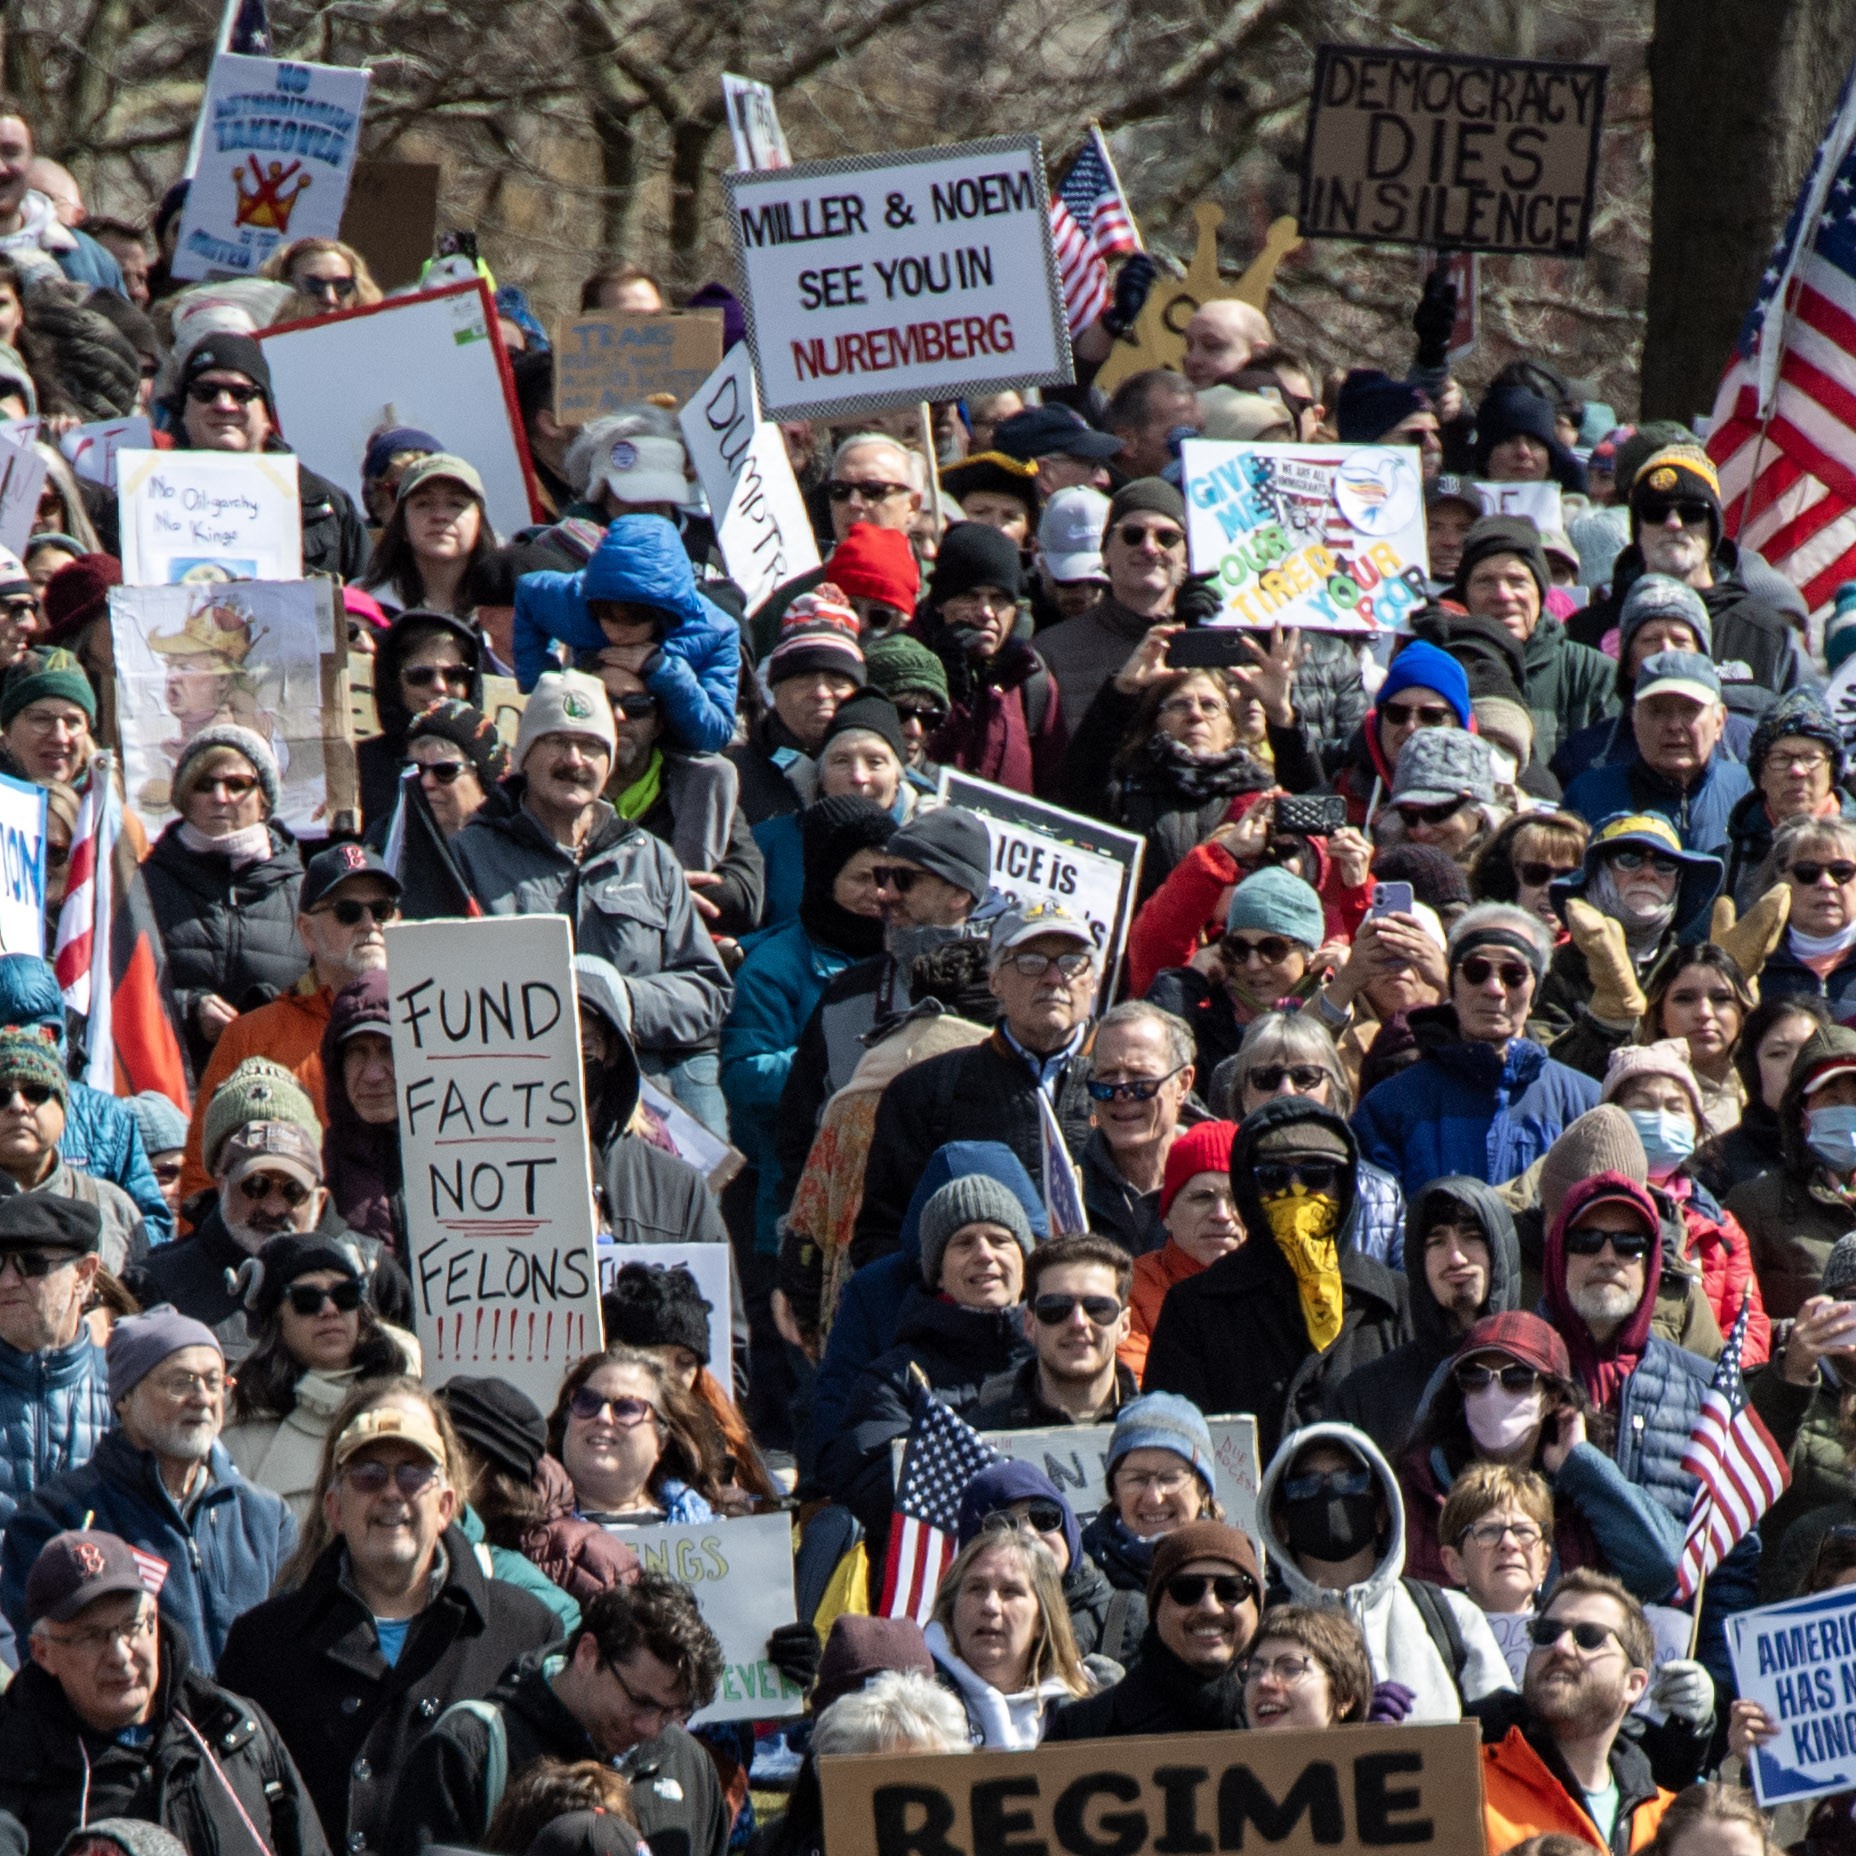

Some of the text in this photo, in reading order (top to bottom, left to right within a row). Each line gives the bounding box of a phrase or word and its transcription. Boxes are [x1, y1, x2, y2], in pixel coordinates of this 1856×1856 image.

[1322, 55, 1594, 128] DEMOCRACY
[1366, 112, 1546, 191] DIES
[743, 170, 1037, 249] MILLER & NOEM
[1313, 176, 1581, 250] IN SILENCE
[798, 246, 994, 311] SEE YOU IN
[790, 312, 1015, 382] NUREMBERG
[1188, 450, 1259, 510] GIVE
[1216, 489, 1276, 543] ME
[1231, 544, 1335, 625] TIRED
[1307, 543, 1404, 623] YOUR
[995, 834, 1044, 885] ICE
[397, 978, 562, 1049] FUND
[405, 1077, 578, 1136] FACTS
[429, 1157, 557, 1217] NOT
[417, 1238, 591, 1316] FELONS
[1774, 1671, 1838, 1721] HAS
